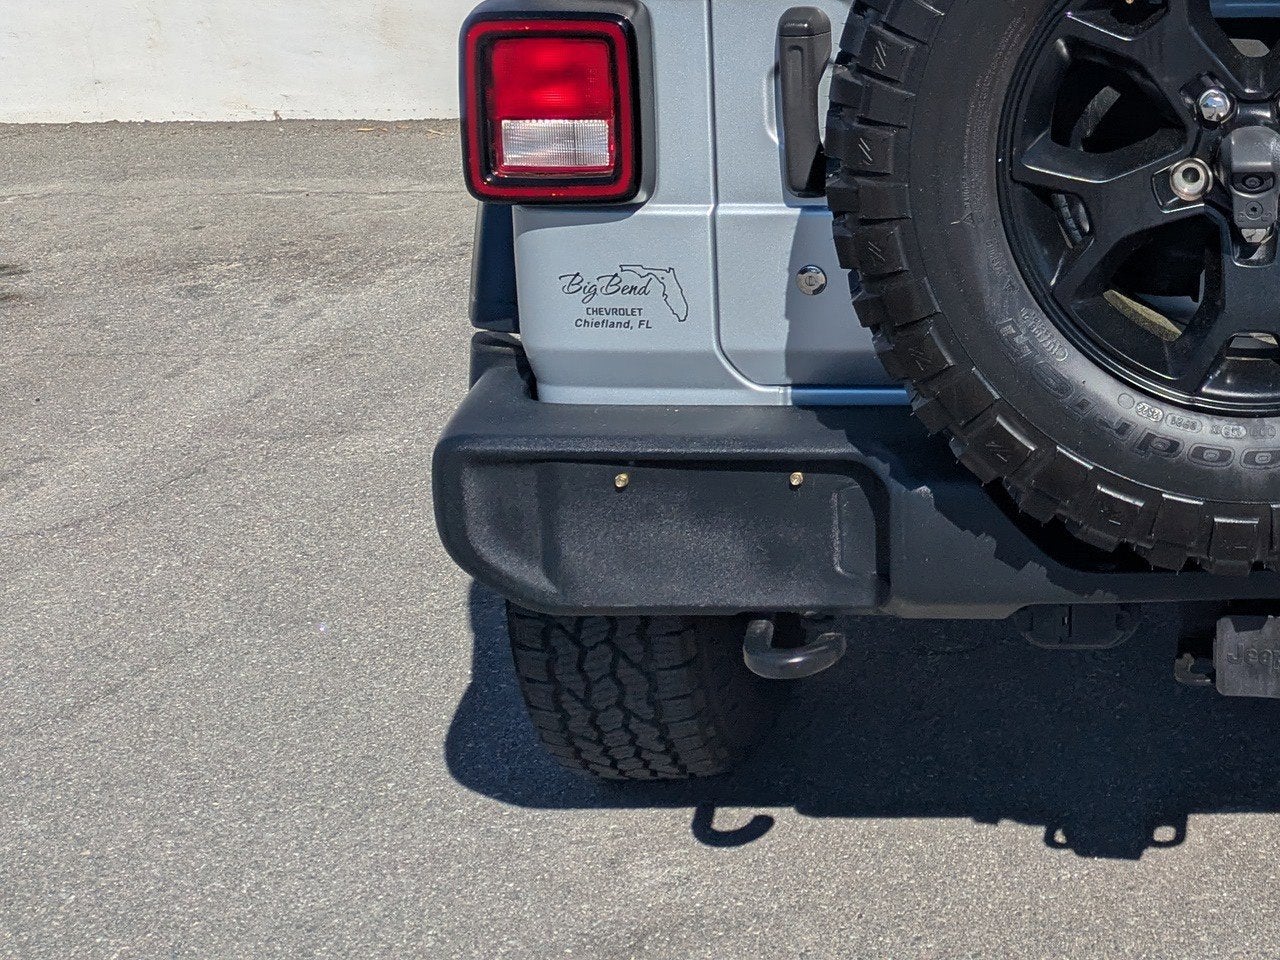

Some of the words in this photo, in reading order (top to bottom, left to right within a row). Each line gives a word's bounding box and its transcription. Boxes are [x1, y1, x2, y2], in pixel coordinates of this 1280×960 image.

[558, 272, 599, 304] Big
[596, 272, 653, 296] Bend
[585, 307, 644, 317] CHEVROLET
[574, 318, 634, 331] Chiefland,
[637, 319, 653, 330] FL
